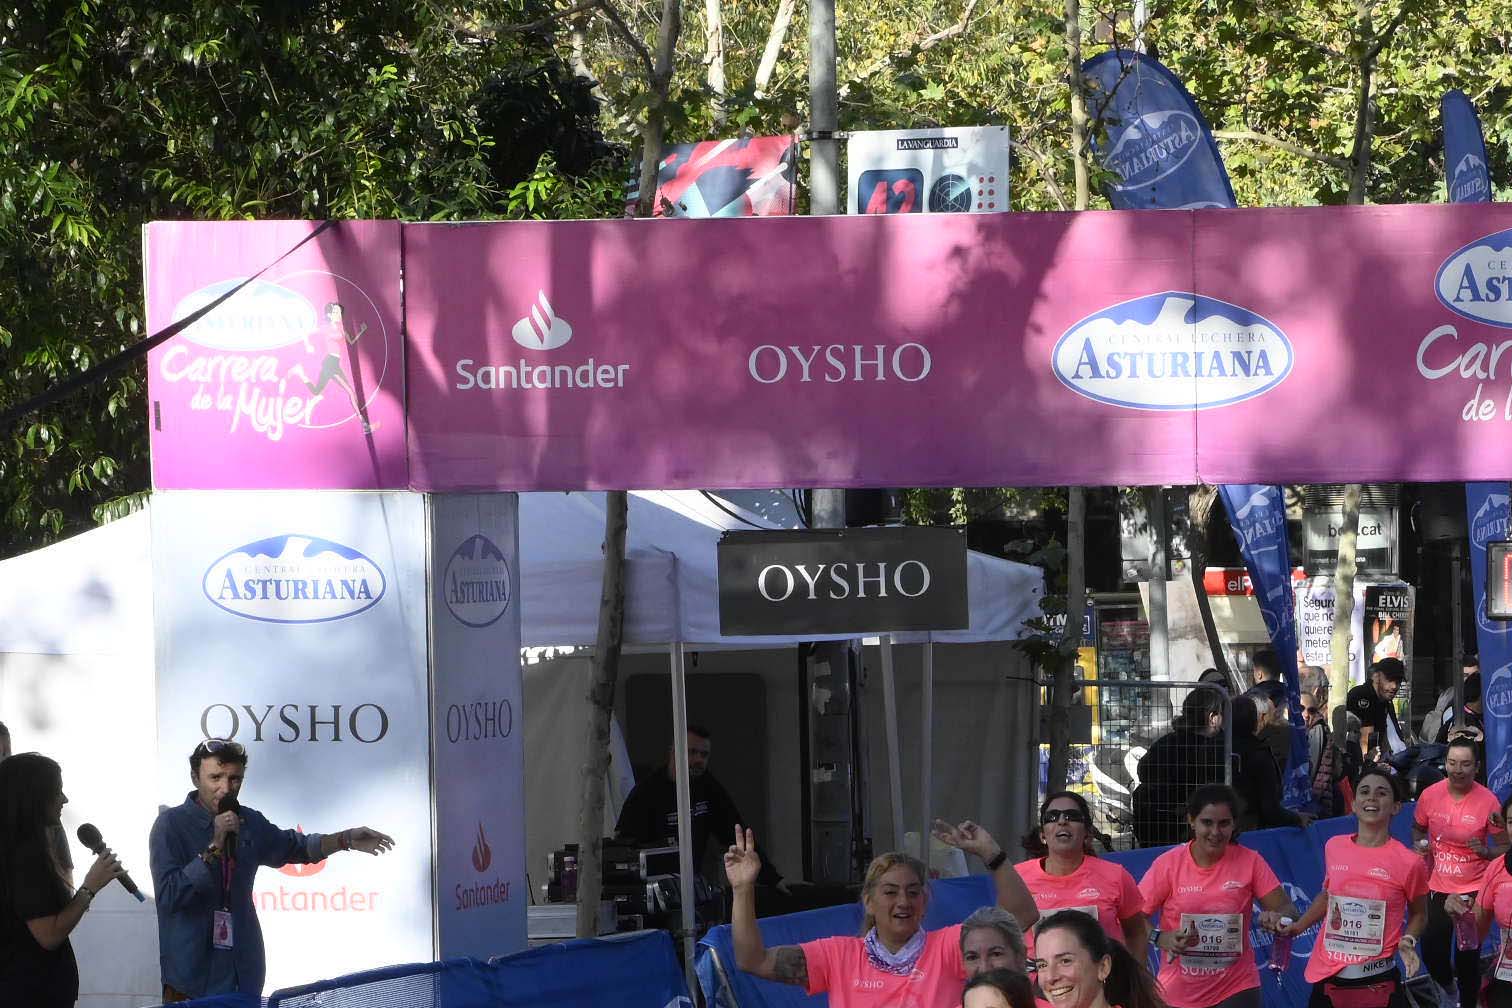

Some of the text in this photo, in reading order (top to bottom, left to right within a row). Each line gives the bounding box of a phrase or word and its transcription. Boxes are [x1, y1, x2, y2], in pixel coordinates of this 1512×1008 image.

[456, 358, 630, 392] Santander
[748, 342, 934, 384] OYSHO
[1071, 336, 1275, 380] ASTURIANA
[1462, 383, 1497, 422] de
[217, 567, 375, 602] ASTURIANA
[449, 570, 507, 605] ASTURIANA
[757, 559, 932, 604] OYSHO
[1378, 595, 1409, 607] ELVIS
[1304, 625, 1336, 637] quiere
[200, 703, 390, 744] OYSHO
[446, 698, 513, 745] OYSHO
[455, 878, 511, 911] Santander
[1201, 935, 1223, 944] 016
[1342, 919, 1363, 929] 016
[1362, 960, 1386, 973] NIKE
